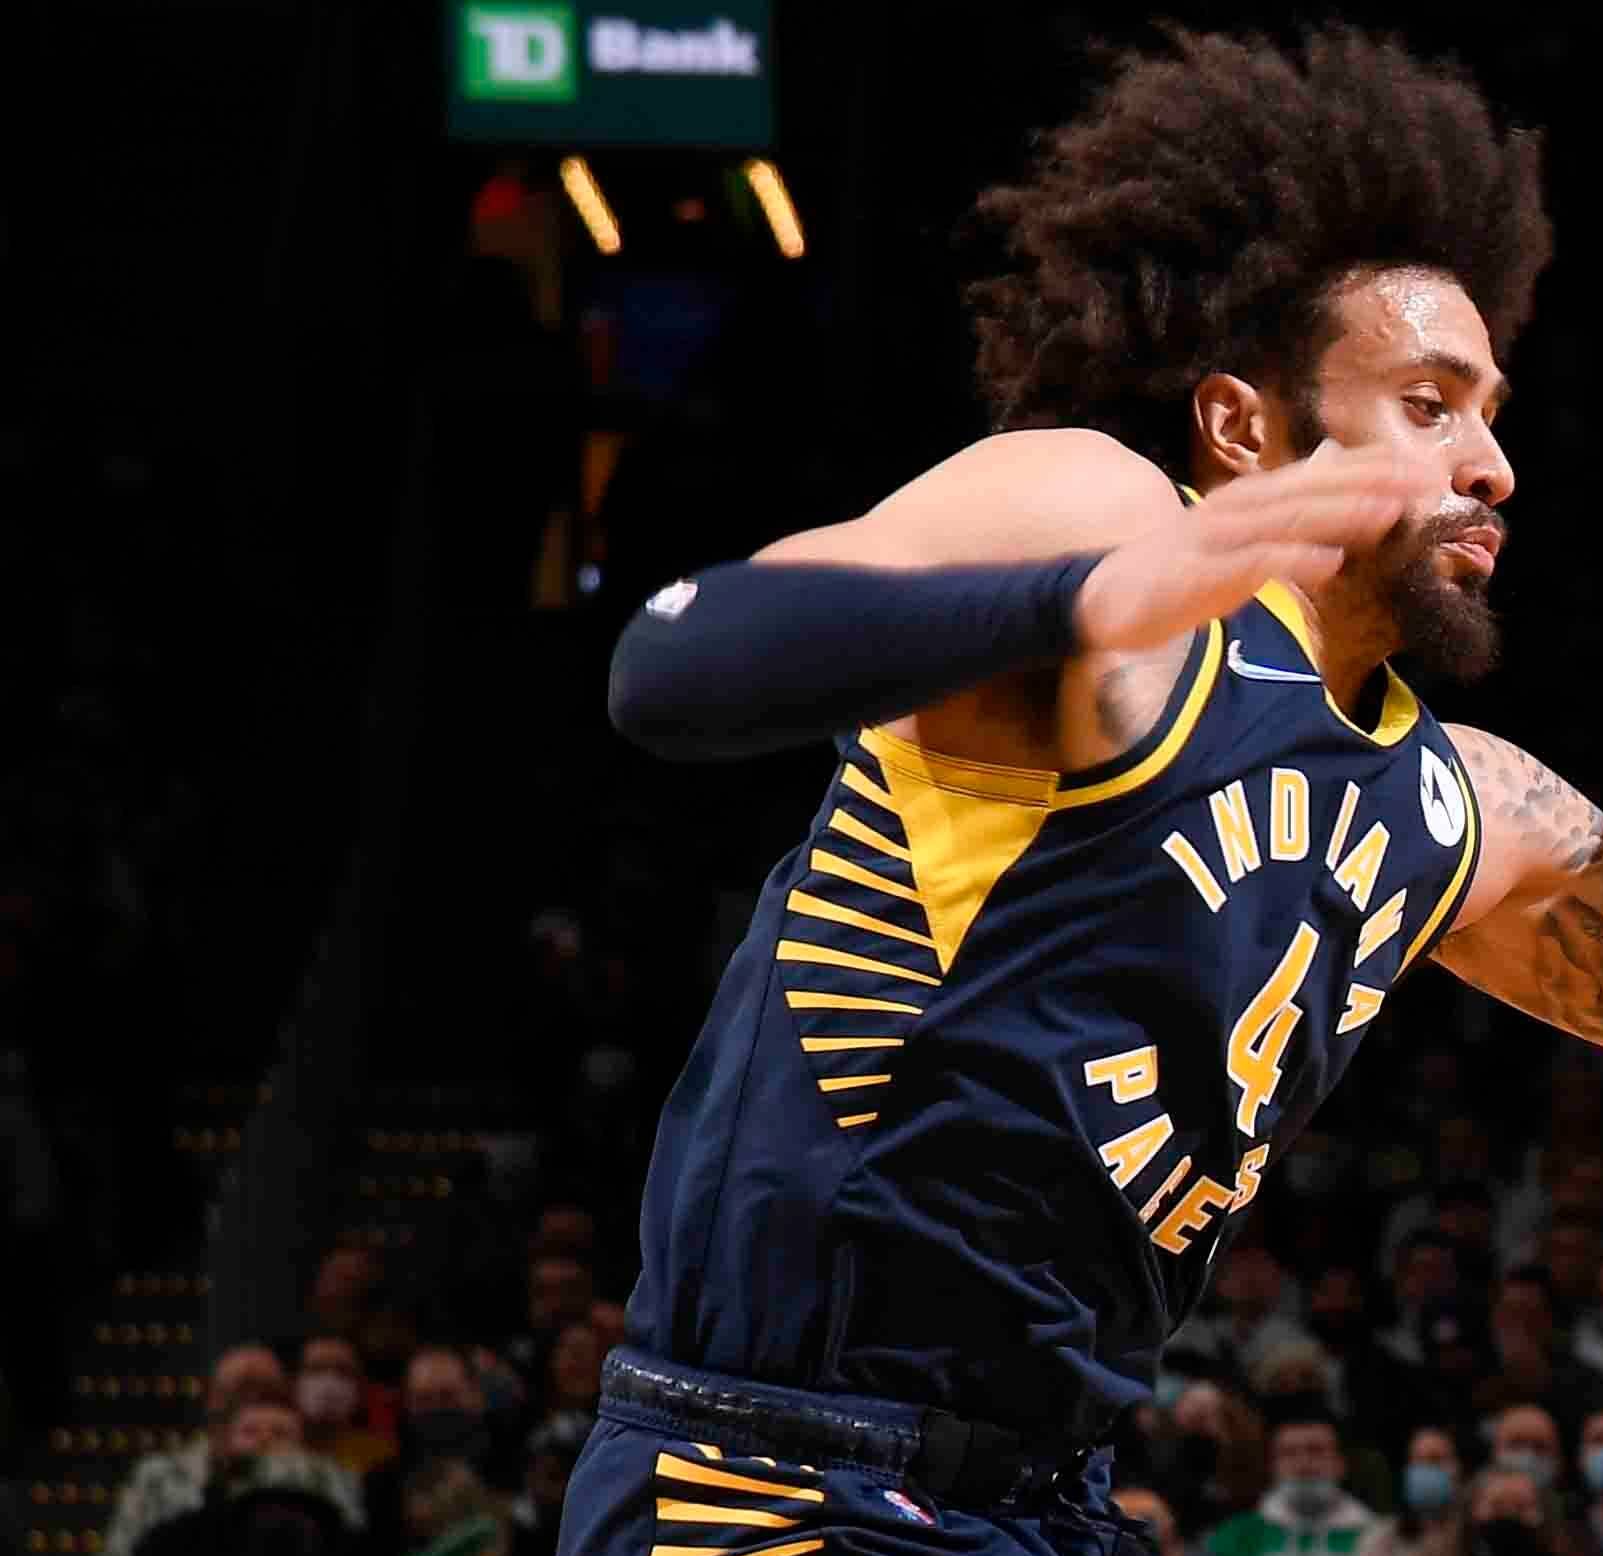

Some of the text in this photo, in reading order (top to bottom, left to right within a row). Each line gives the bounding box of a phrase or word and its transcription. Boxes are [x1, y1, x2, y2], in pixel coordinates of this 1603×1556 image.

[471, 12, 757, 82] TD Bank
[1227, 920, 1321, 1138] 4
